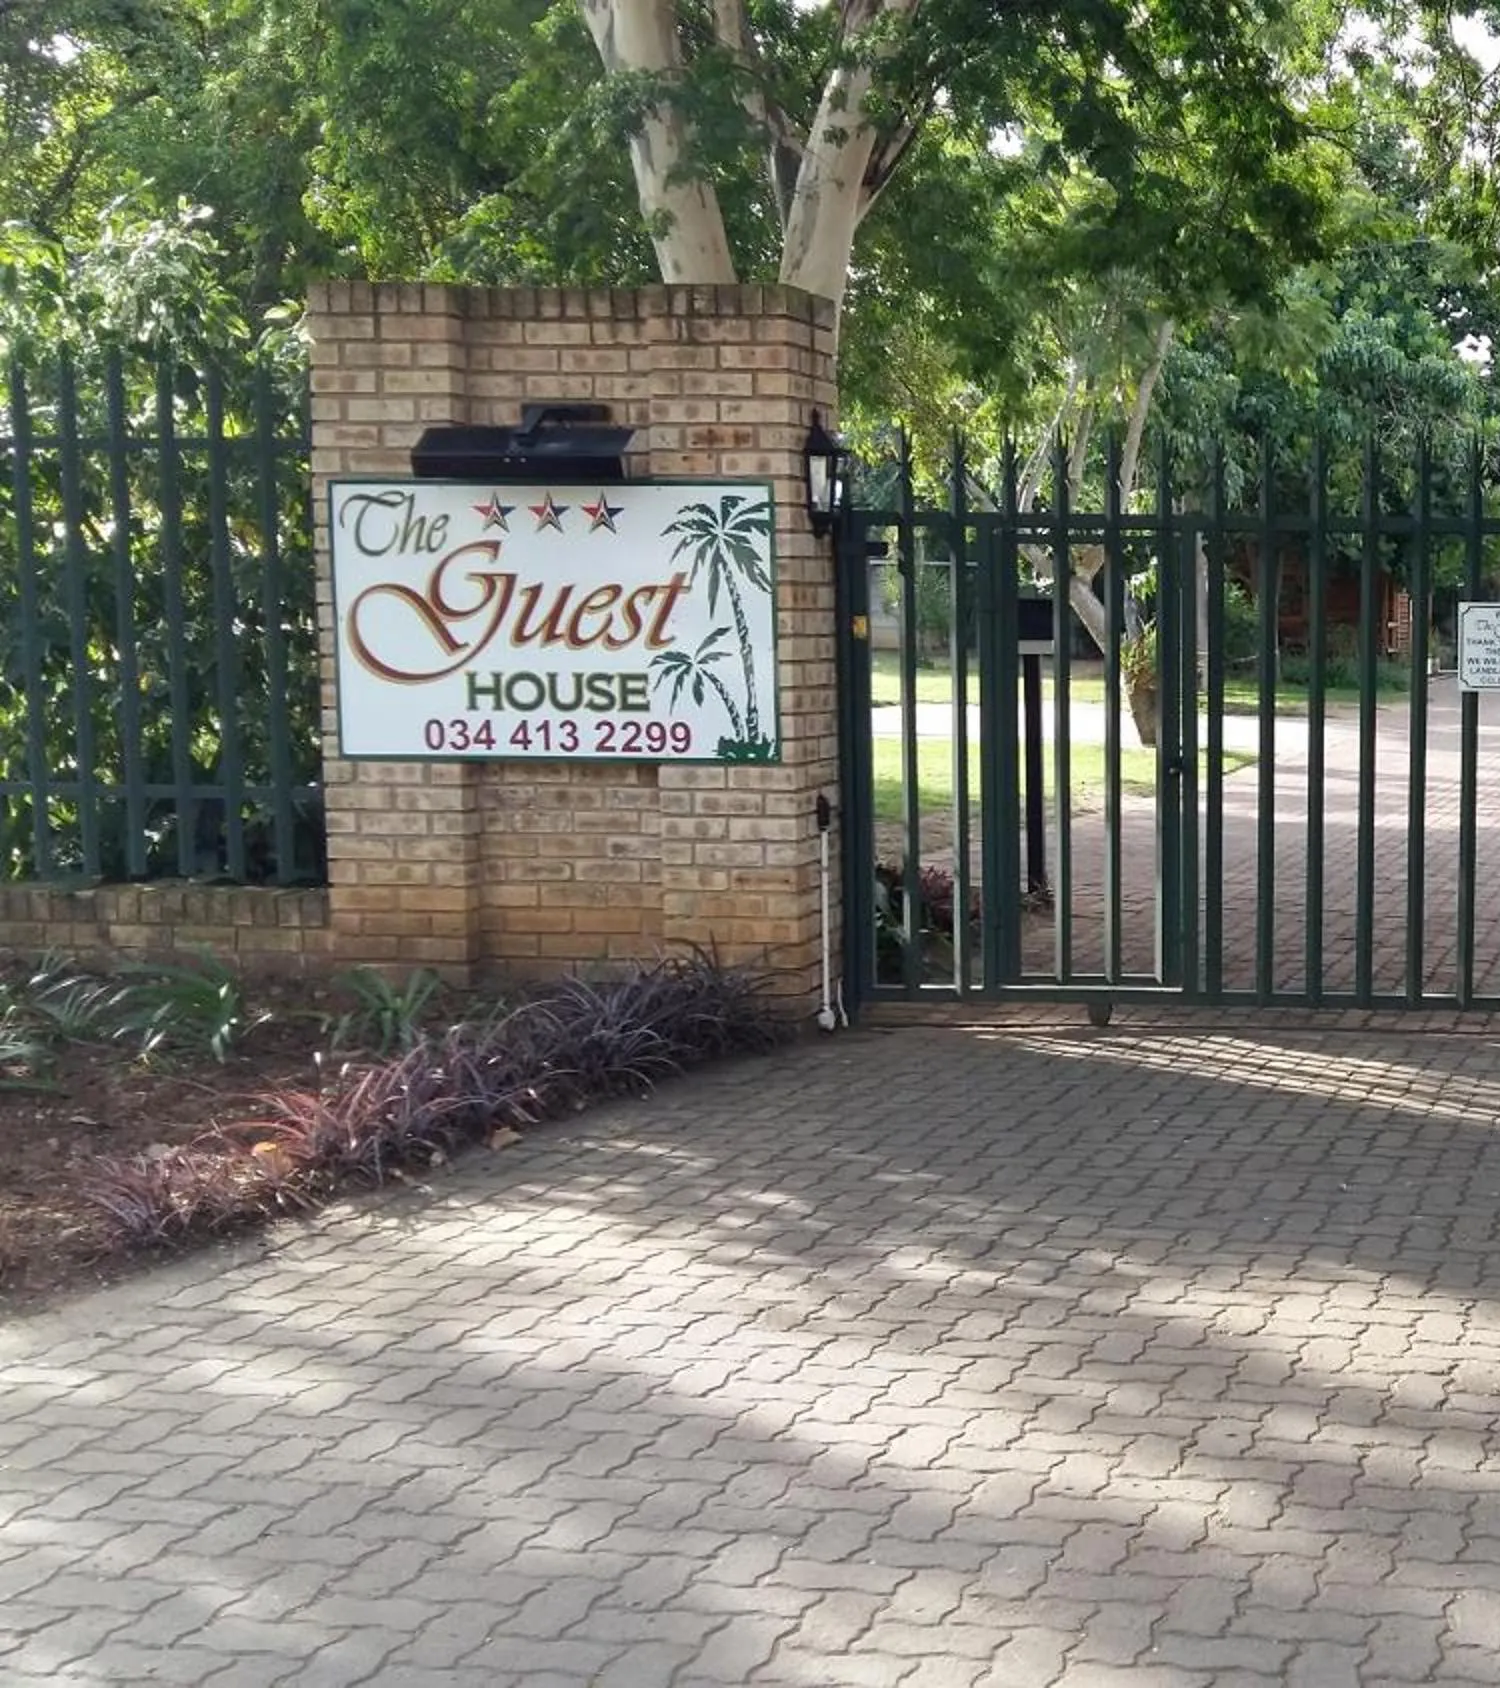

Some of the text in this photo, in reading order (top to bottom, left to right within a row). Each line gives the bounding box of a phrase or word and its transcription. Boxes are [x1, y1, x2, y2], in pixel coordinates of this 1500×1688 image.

[339, 490, 451, 557] The
[347, 540, 693, 685] Guest
[1466, 639, 1495, 647] THANK
[1467, 658, 1480, 666] WE
[465, 671, 651, 712] HOUSE
[424, 719, 692, 754] 034 413 2299
